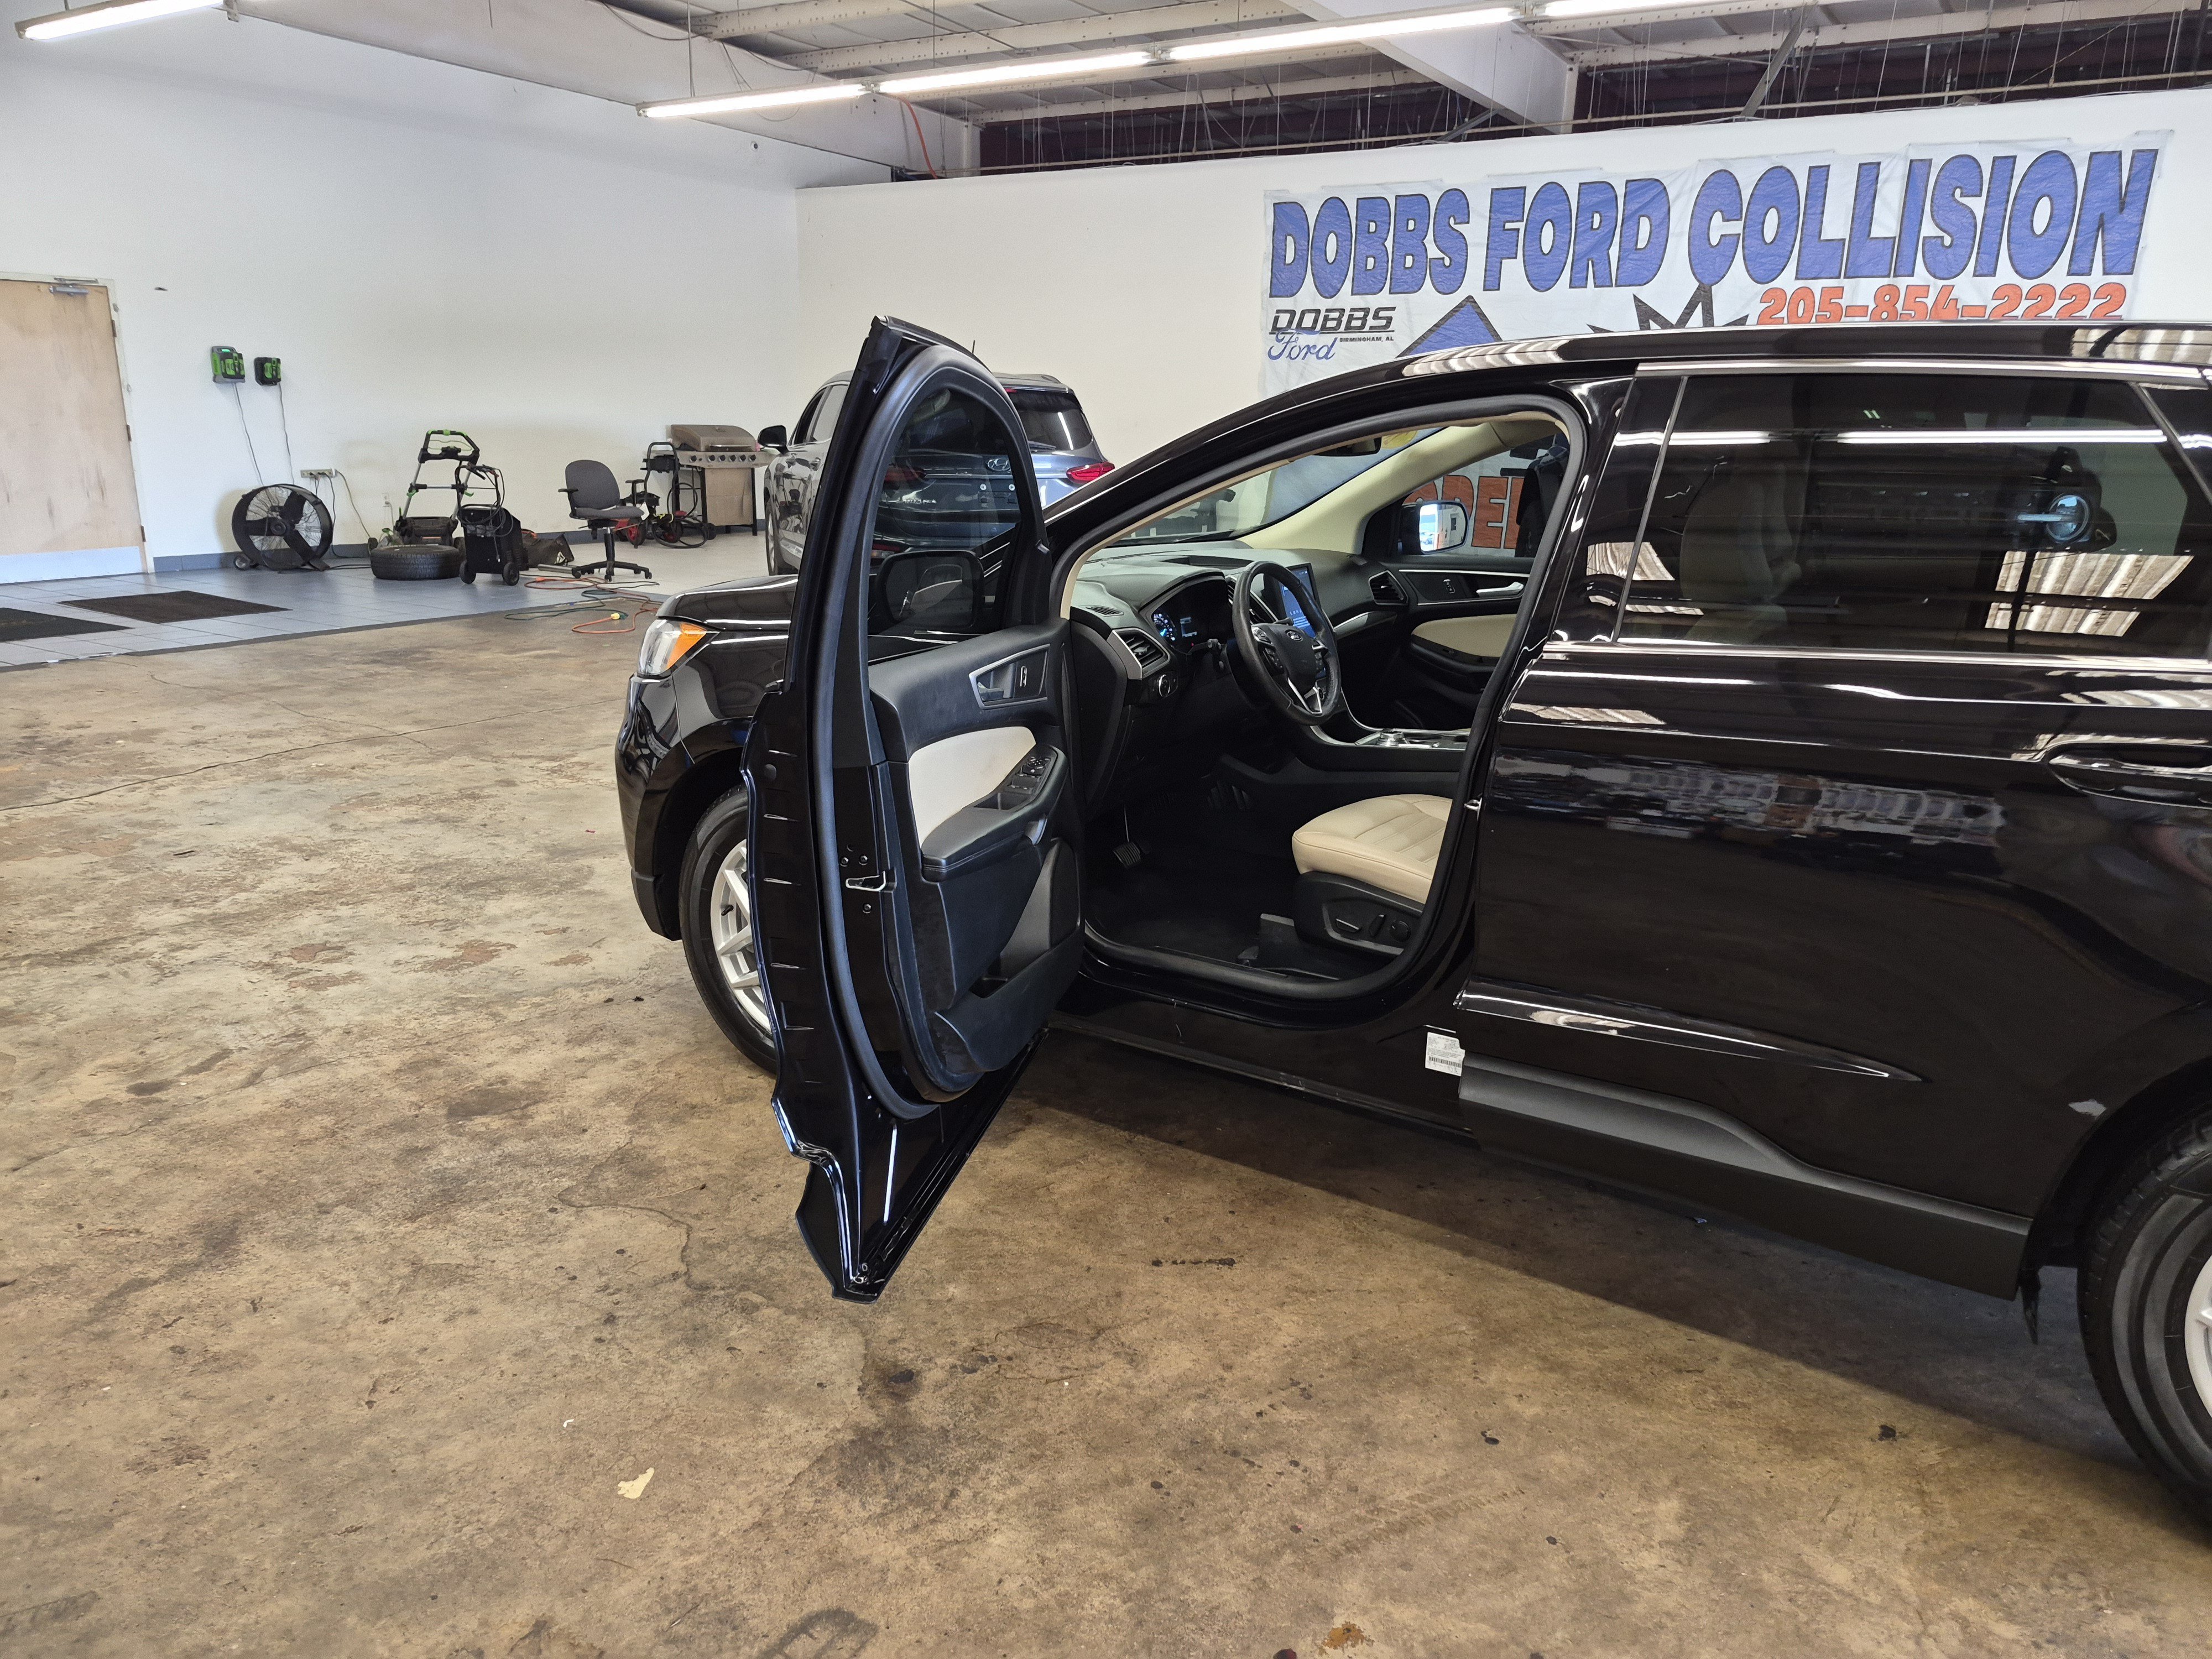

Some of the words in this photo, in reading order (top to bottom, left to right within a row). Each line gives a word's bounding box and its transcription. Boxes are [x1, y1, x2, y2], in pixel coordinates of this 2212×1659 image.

[1269, 188, 1470, 299] DOBBS
[1483, 178, 1671, 293] FORD
[1687, 149, 2158, 286] COLLISION
[1270, 306, 1397, 332] DOBBS
[1757, 282, 2127, 326] 205-854-2222
[1267, 328, 1338, 361] Ford
